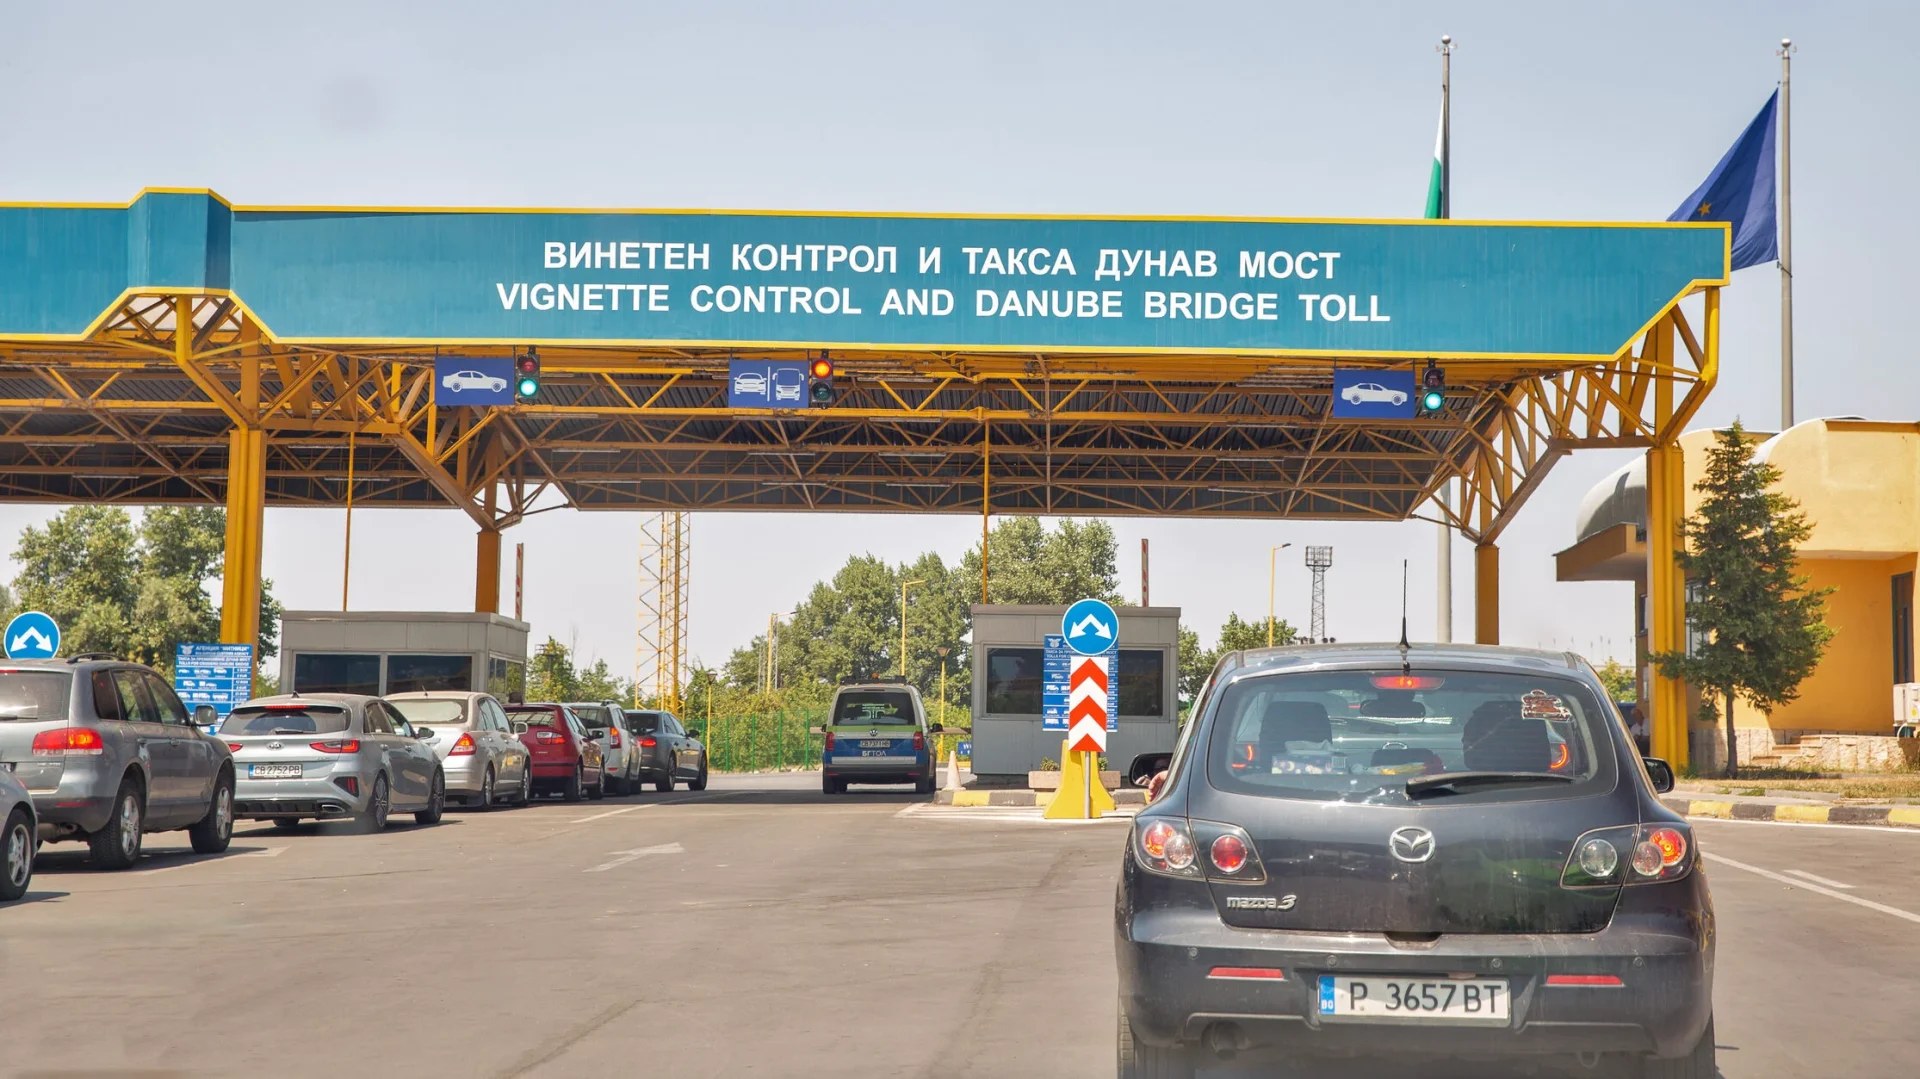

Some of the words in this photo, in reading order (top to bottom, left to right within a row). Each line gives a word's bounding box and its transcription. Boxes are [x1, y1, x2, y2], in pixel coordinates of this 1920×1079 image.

[544, 242, 710, 271] ВИНЕТЕН
[732, 244, 897, 273] КОНТРОЛ
[919, 247, 941, 274] И
[962, 248, 1077, 276] ТАКСА
[1094, 250, 1218, 281] ДУНАВ
[1239, 251, 1341, 280] МОСТ
[496, 283, 670, 312] VIGNETTE
[690, 285, 862, 315] CONTROL
[879, 289, 954, 316] AND
[976, 290, 1123, 318] DANUBE
[1144, 292, 1278, 320] BRIDGE
[1298, 295, 1391, 322] TOLL
